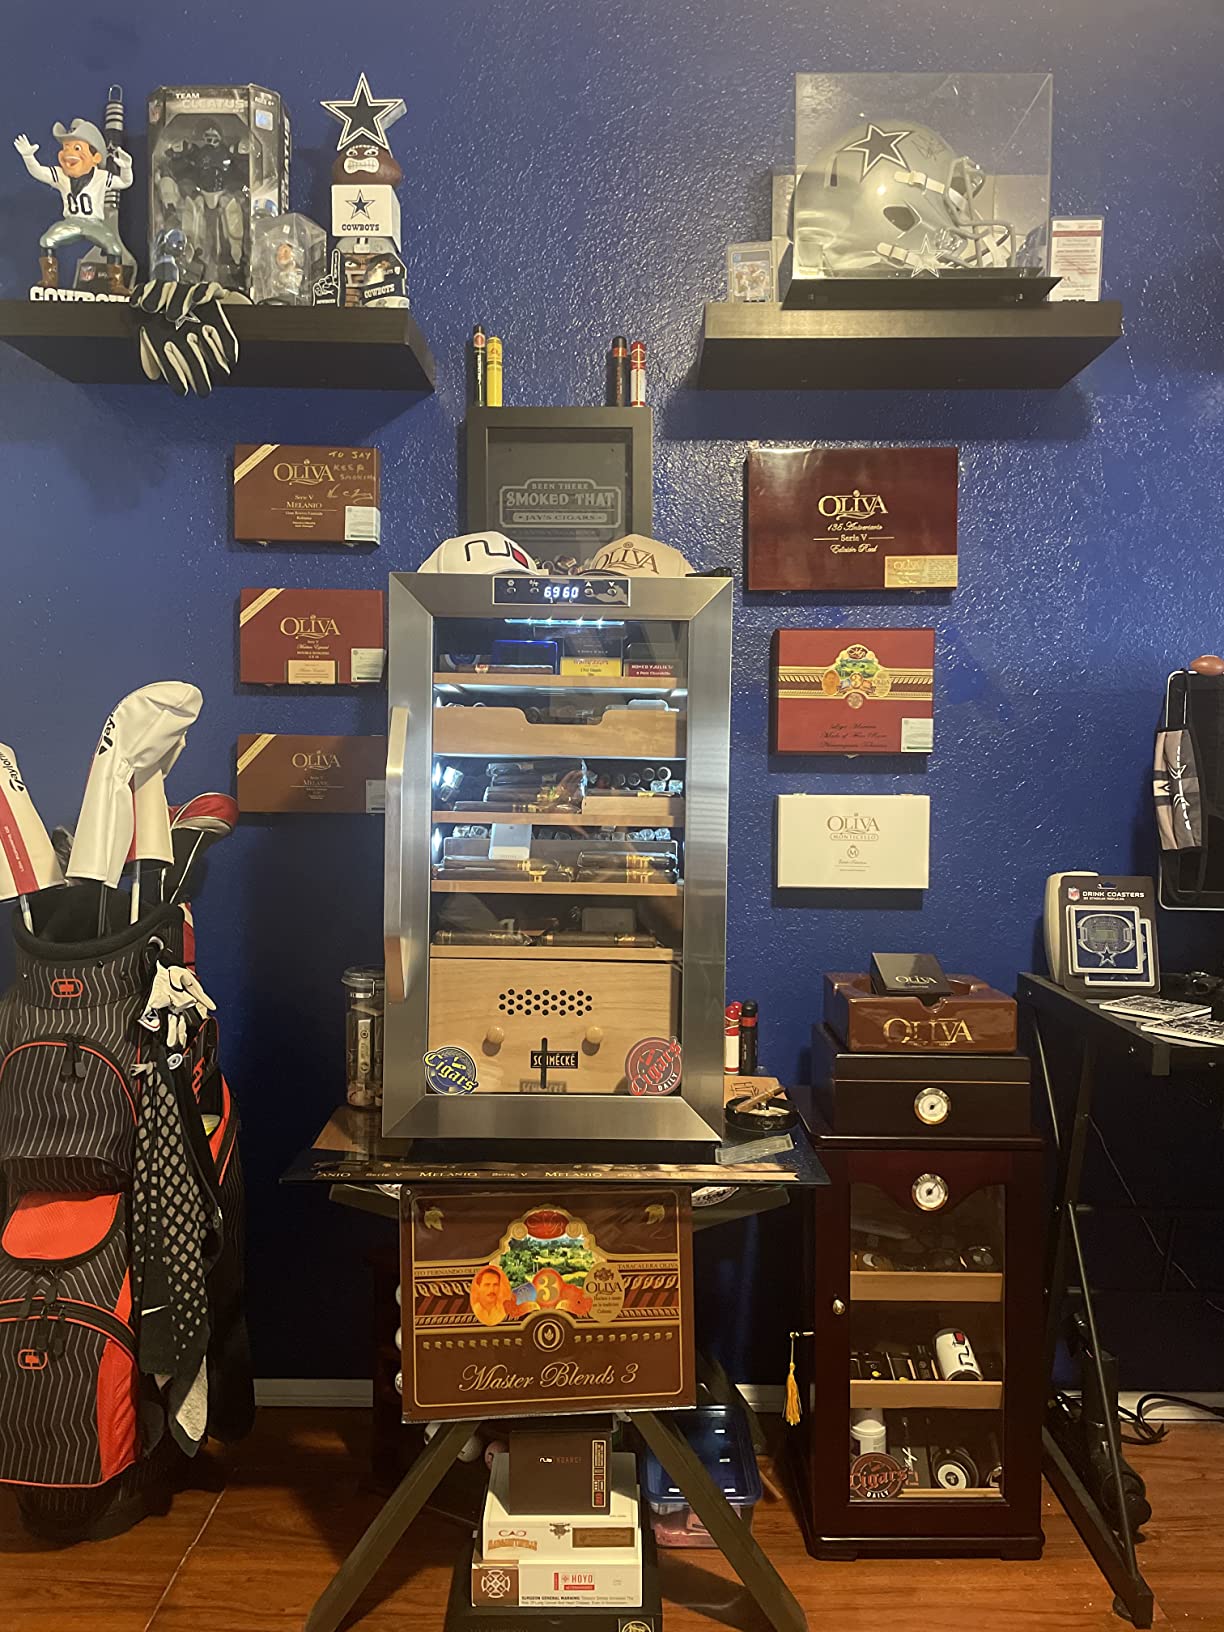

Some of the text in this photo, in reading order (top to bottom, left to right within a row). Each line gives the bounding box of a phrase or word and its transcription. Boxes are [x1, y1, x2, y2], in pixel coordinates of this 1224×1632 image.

[176, 92, 201, 100] TEAM
[67, 193, 93, 216] 00
[341, 223, 381, 232] COWBOYS
[363, 284, 396, 299] COWBOYS
[273, 460, 336, 486] OLIVA
[531, 482, 590, 491] BEEN THERE
[506, 491, 616, 508] SMOKED THAT
[817, 489, 889, 521] OLIVA
[280, 614, 341, 640] OLIVA
[292, 750, 342, 771] OLIVA
[827, 812, 880, 835] OLIVA
[1106, 891, 1145, 899] COASTERS
[895, 976, 938, 985] OLIVA
[883, 1018, 976, 1046] OLIVA
[657, 1072, 678, 1092] DAILY
[537, 1275, 561, 1302] 3
[585, 1281, 623, 1297] OLIVA
[459, 1361, 639, 1392] Master Blends 3
[866, 1490, 889, 1499] DAILY
[571, 1574, 594, 1584] HOYO
